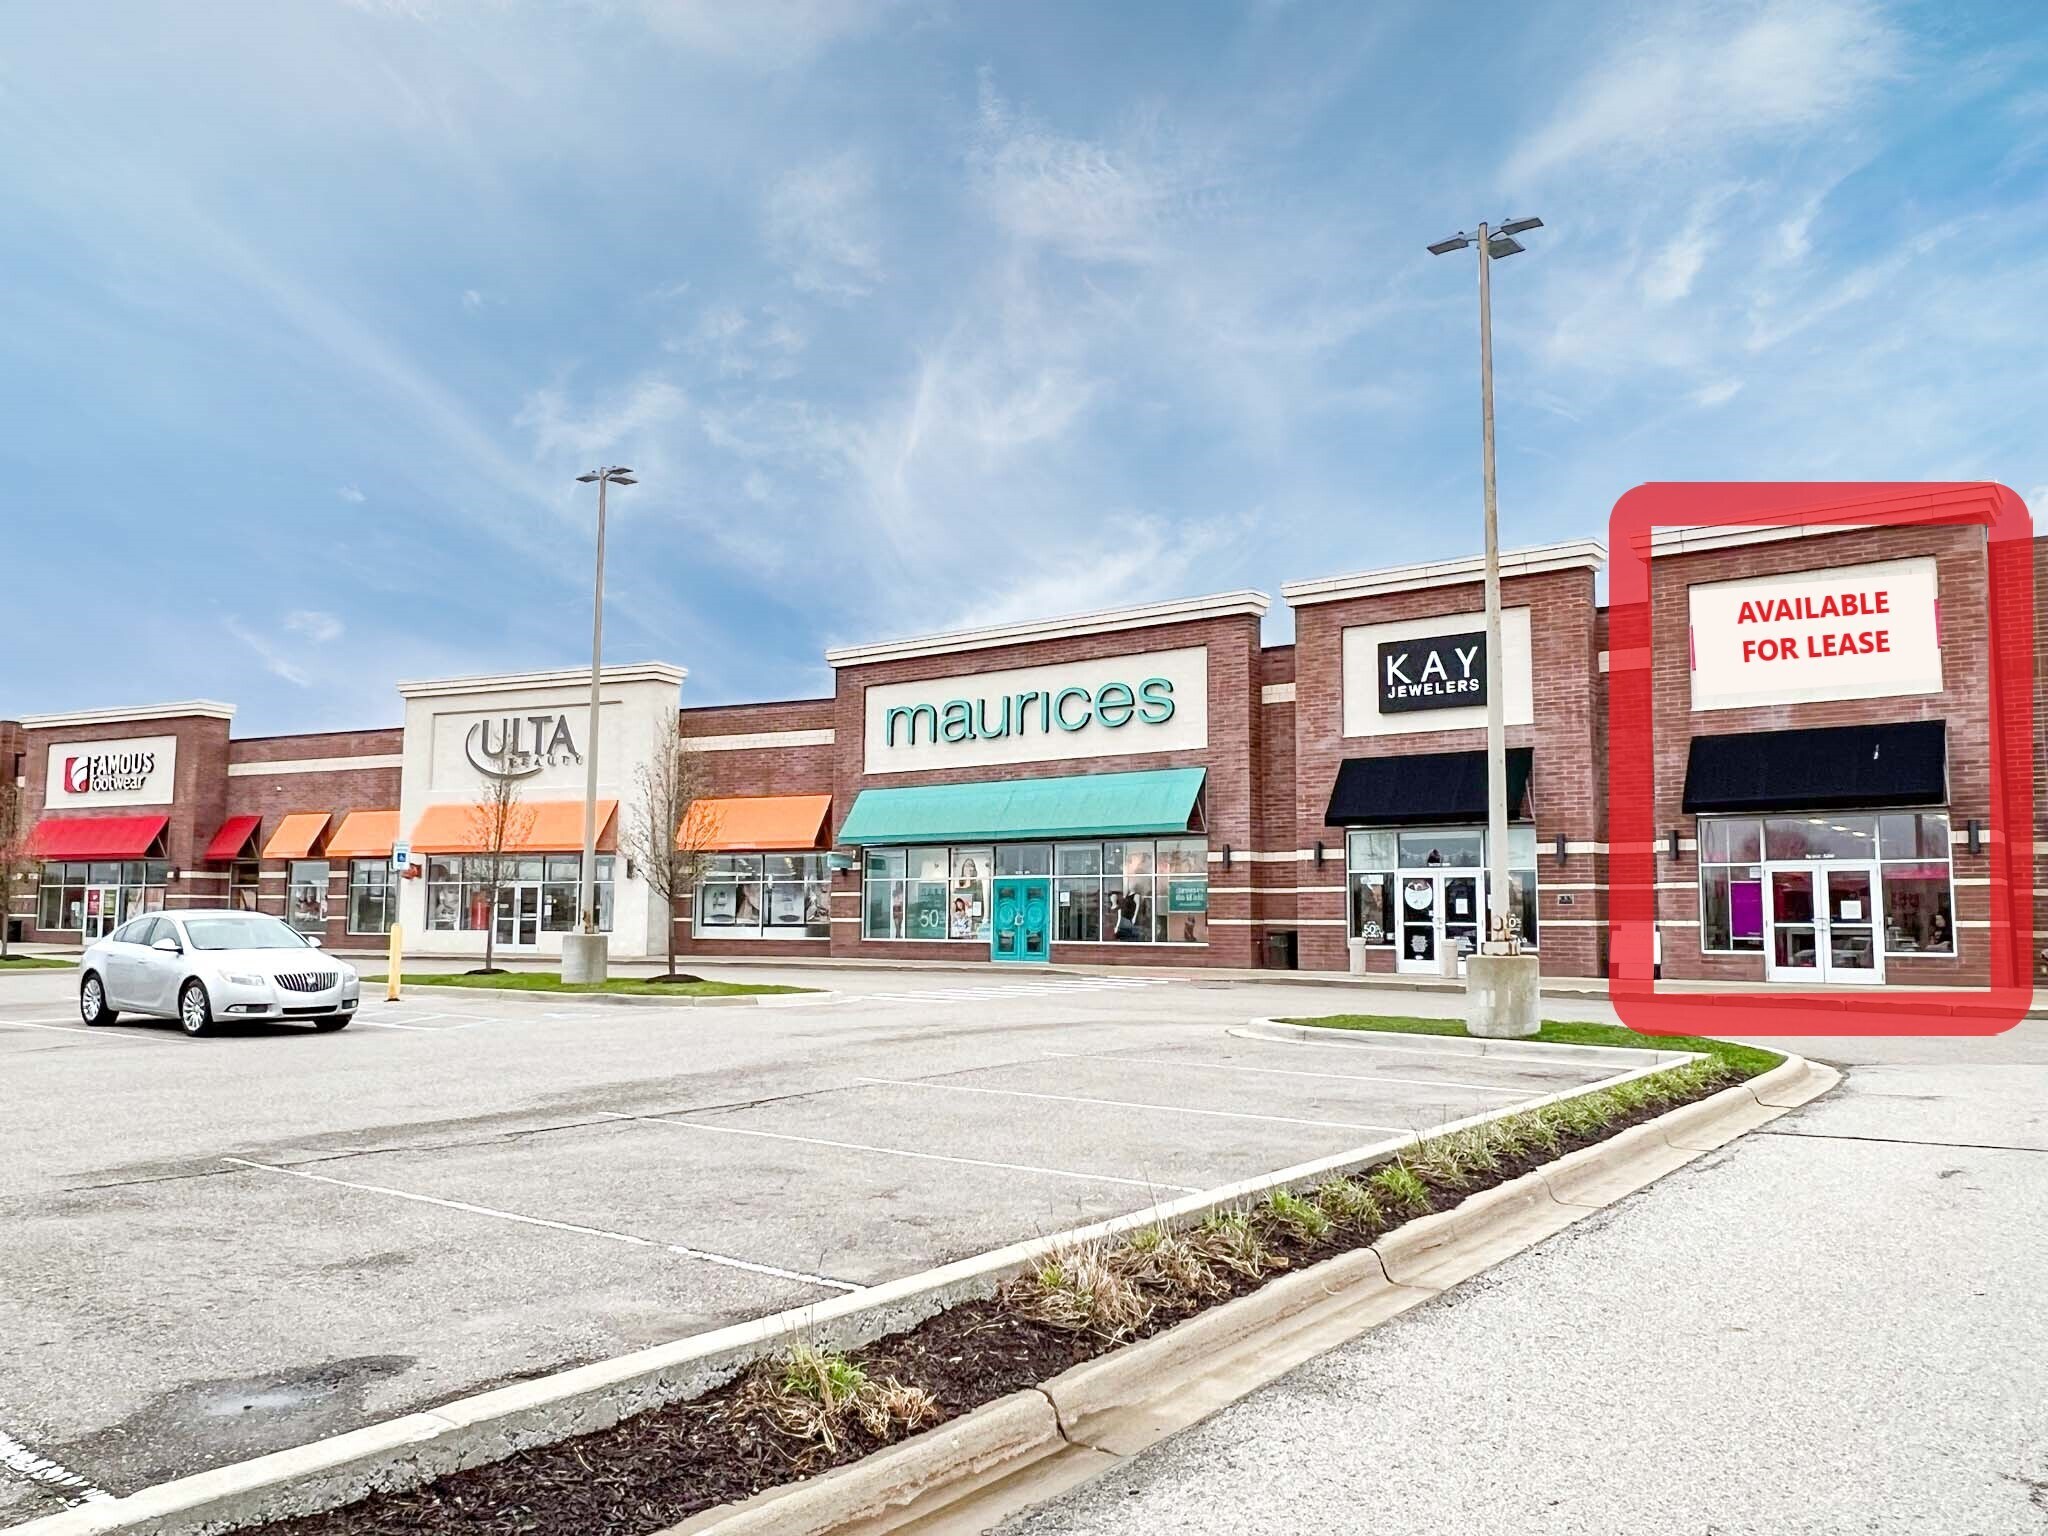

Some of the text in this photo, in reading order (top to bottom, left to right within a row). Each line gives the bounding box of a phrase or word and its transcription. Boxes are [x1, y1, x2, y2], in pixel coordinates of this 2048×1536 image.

[1386, 646, 1478, 686] KAY
[1387, 679, 1480, 699] JEWELERS
[885, 677, 1175, 747] maurices
[481, 714, 579, 759] ULTA
[91, 752, 155, 776] FAMOUS
